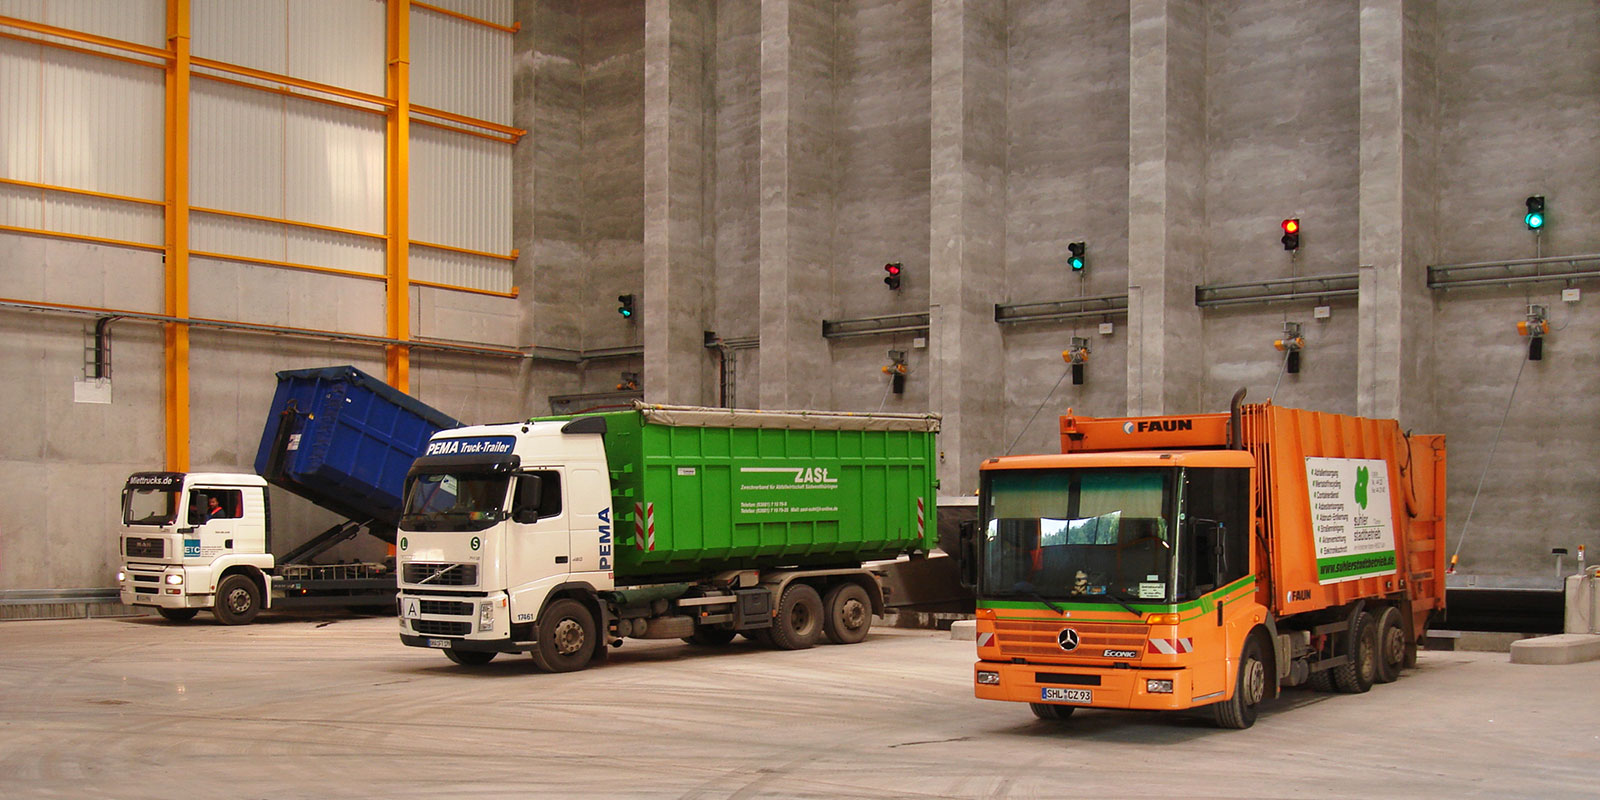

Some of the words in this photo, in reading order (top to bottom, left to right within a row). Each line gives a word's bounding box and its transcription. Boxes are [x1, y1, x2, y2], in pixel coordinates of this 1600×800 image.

[1137, 419, 1193, 433] FAUN
[425, 441, 460, 456] PEMA
[460, 441, 511, 454] Truck-Trailer
[129, 476, 172, 485] Miettrucks.de
[794, 467, 838, 483] ZASt
[597, 506, 611, 570] PEMA
[184, 546, 201, 554] ETC
[1320, 556, 1395, 574] www.suhlerstadtbetrieb.de
[1292, 590, 1312, 602] FAUN
[408, 602, 417, 616] A
[517, 613, 534, 621] 17461
[1047, 689, 1063, 699] SHL
[1067, 690, 1079, 700] CZ
[1079, 691, 1091, 701] 93
